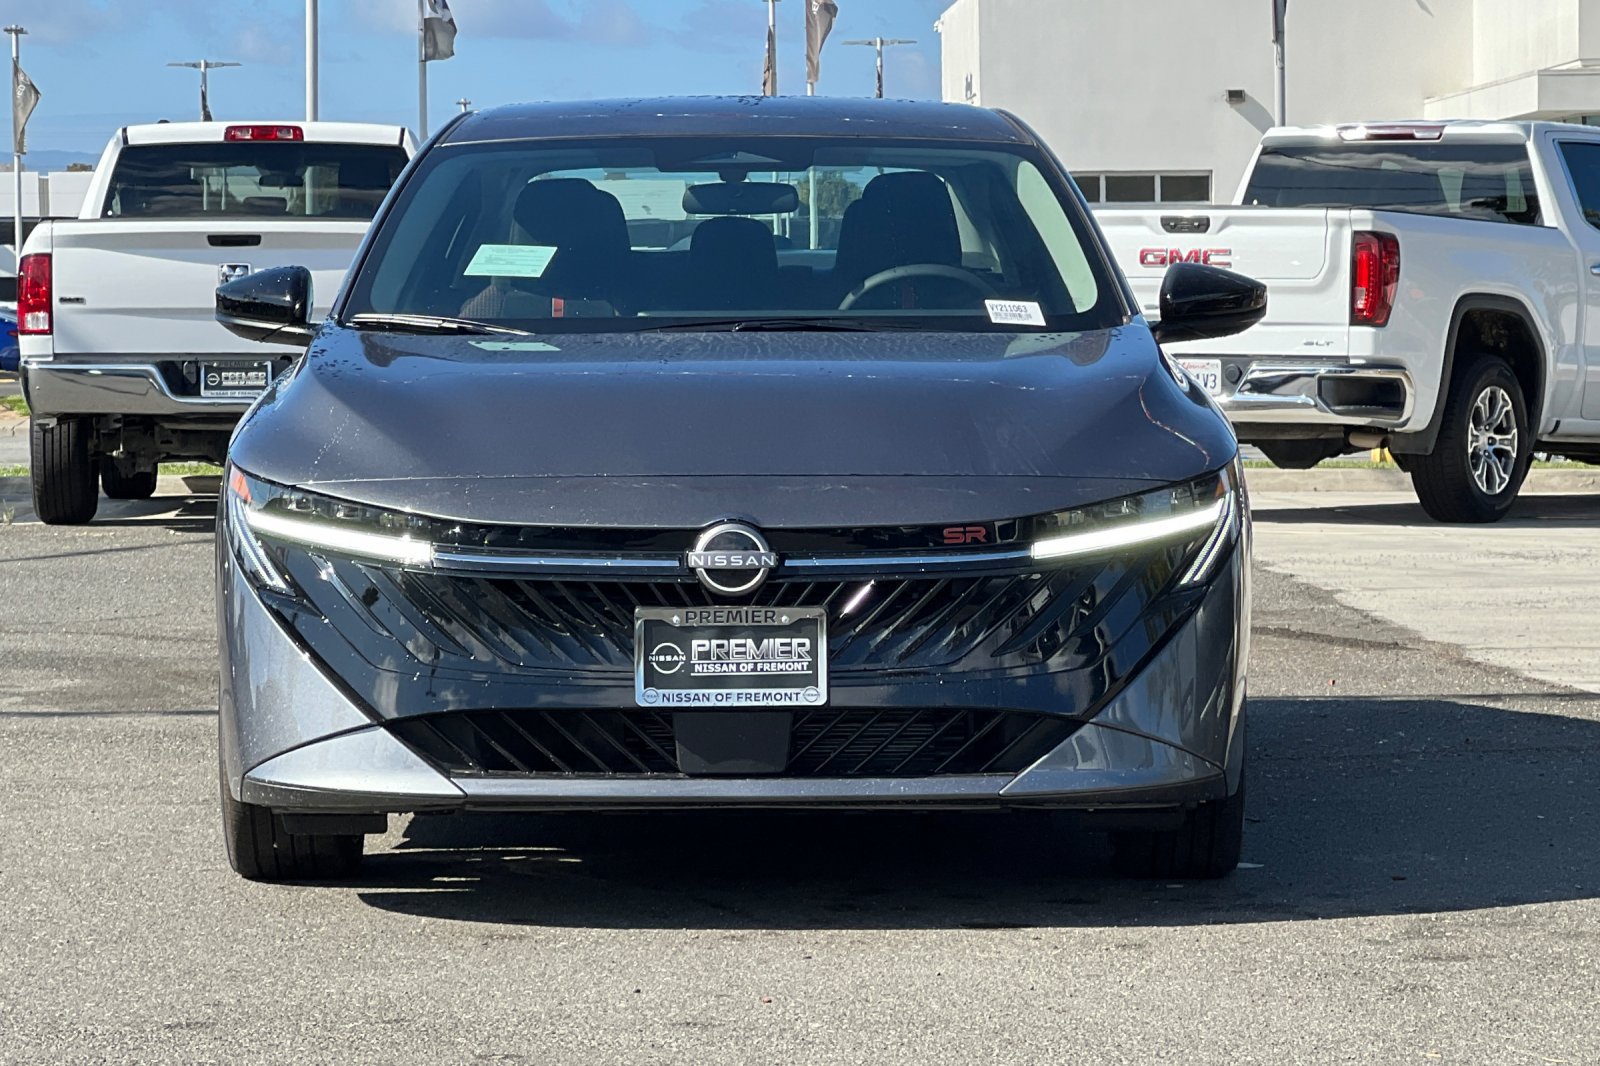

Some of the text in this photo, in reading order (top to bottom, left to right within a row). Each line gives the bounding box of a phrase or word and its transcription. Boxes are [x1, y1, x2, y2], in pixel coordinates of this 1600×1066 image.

[1139, 248, 1232, 268] GMC
[943, 527, 986, 543] SR
[691, 555, 775, 566] NISSAN
[685, 610, 776, 624] PREMIER
[691, 638, 811, 660] PREMIER
[694, 662, 809, 673] NISSAN OF FREMONT
[662, 692, 711, 703] NISSAN
[714, 692, 733, 702] OF
[736, 692, 801, 702] FREMONT
